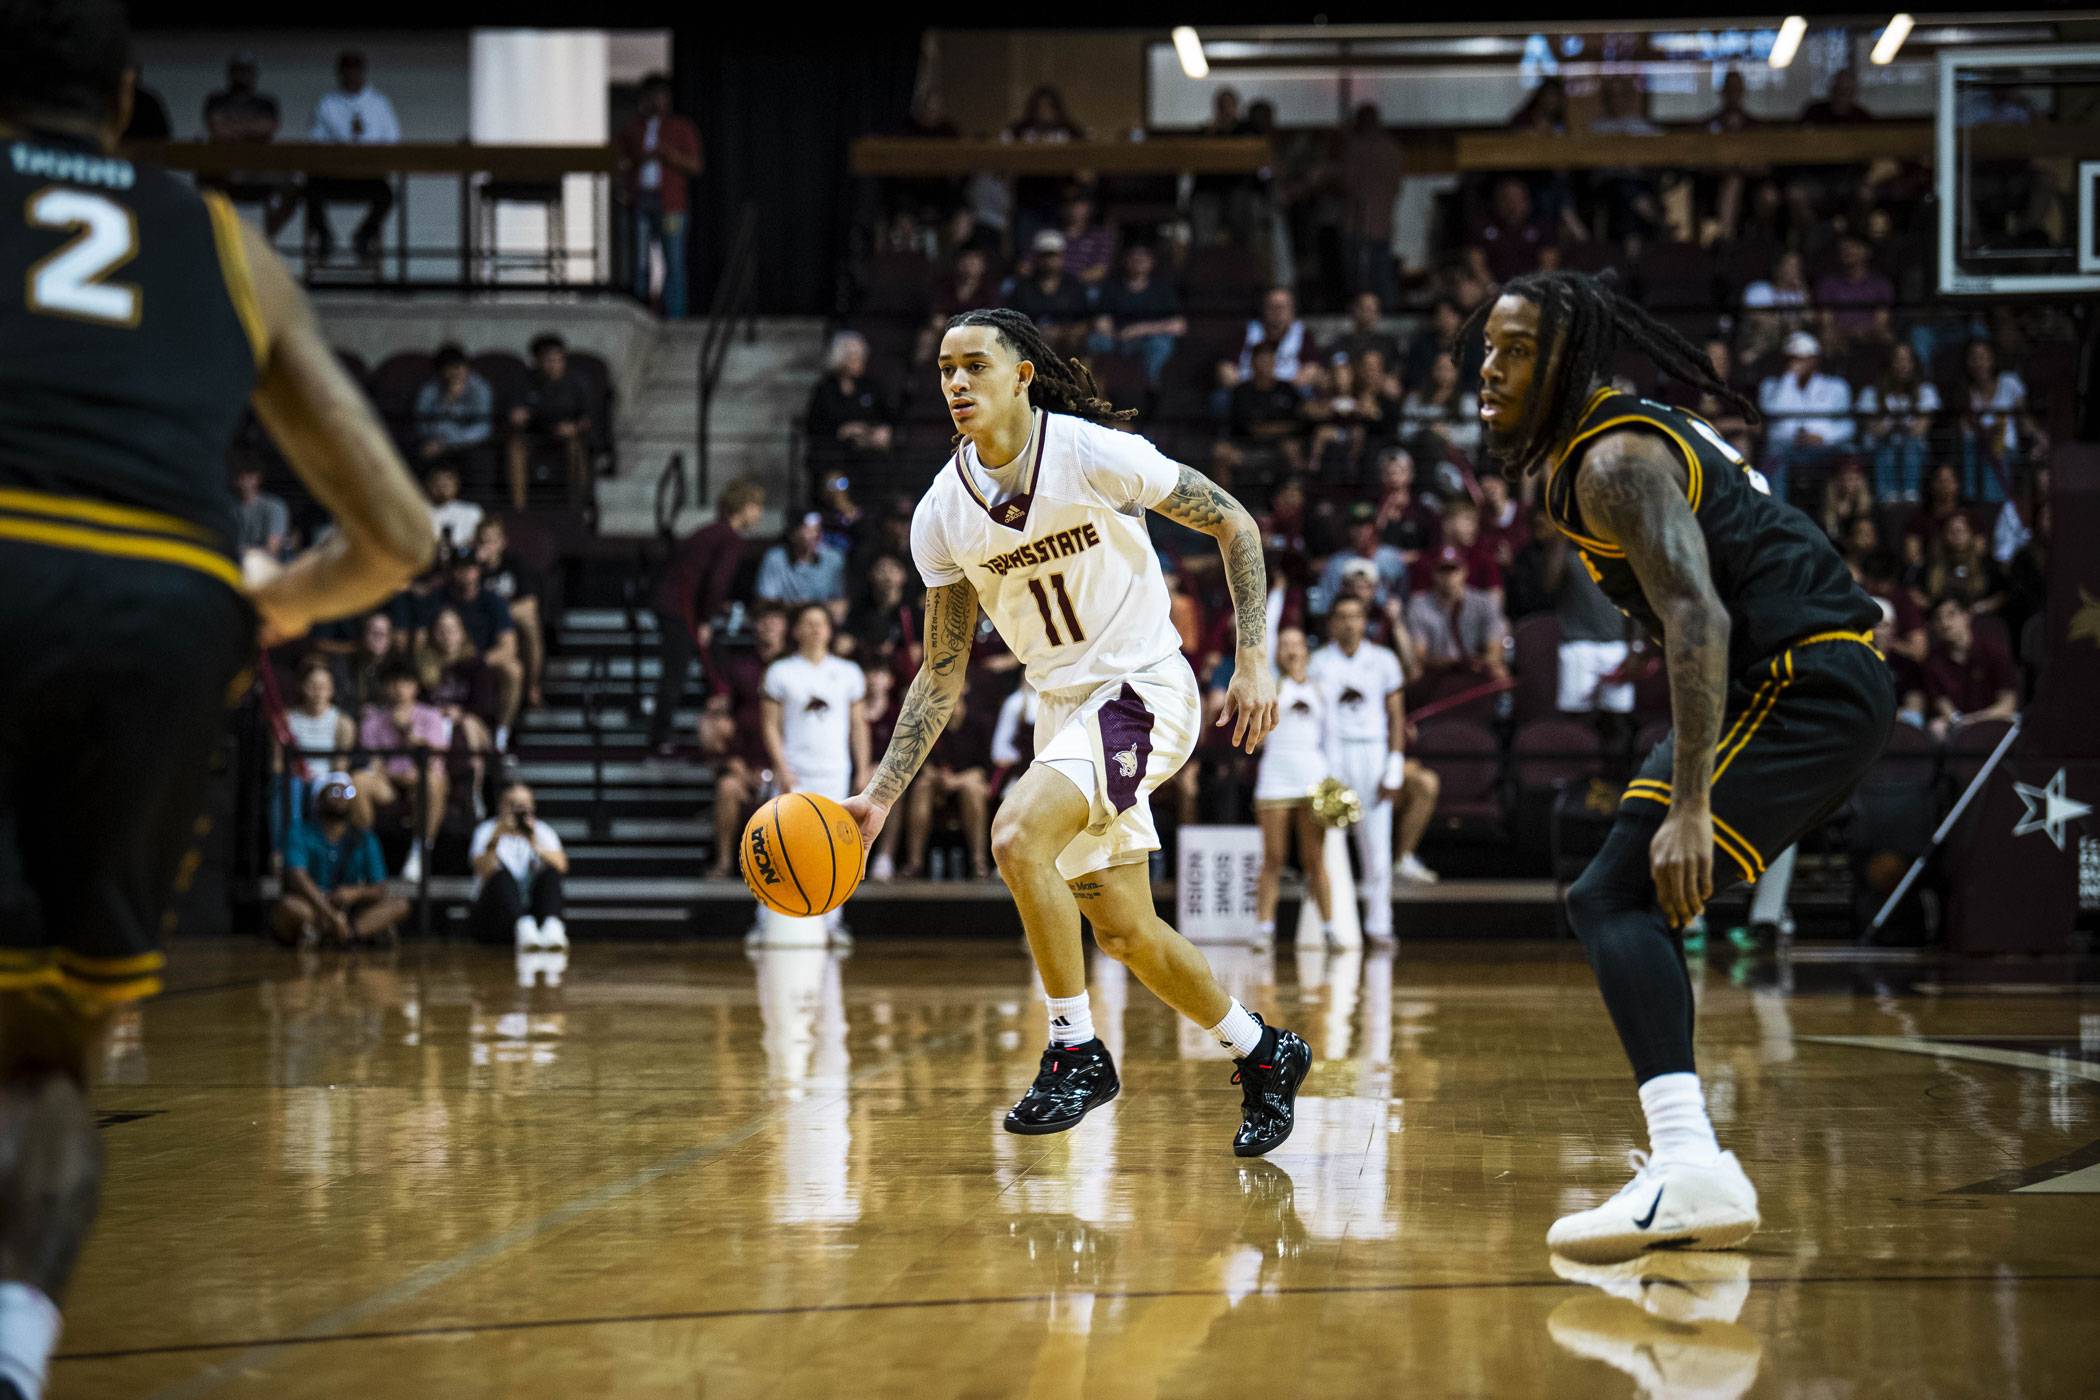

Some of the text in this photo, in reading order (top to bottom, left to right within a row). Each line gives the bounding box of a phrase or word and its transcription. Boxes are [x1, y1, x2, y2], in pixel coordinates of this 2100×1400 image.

[26, 186, 143, 328] 2
[1004, 510, 1026, 524] adidas
[931, 587, 941, 648] ATIENCE
[1027, 571, 1086, 647] 11
[751, 826, 781, 885] NCAA
[1185, 852, 1205, 917] NOISE
[1212, 852, 1233, 916] SOME
